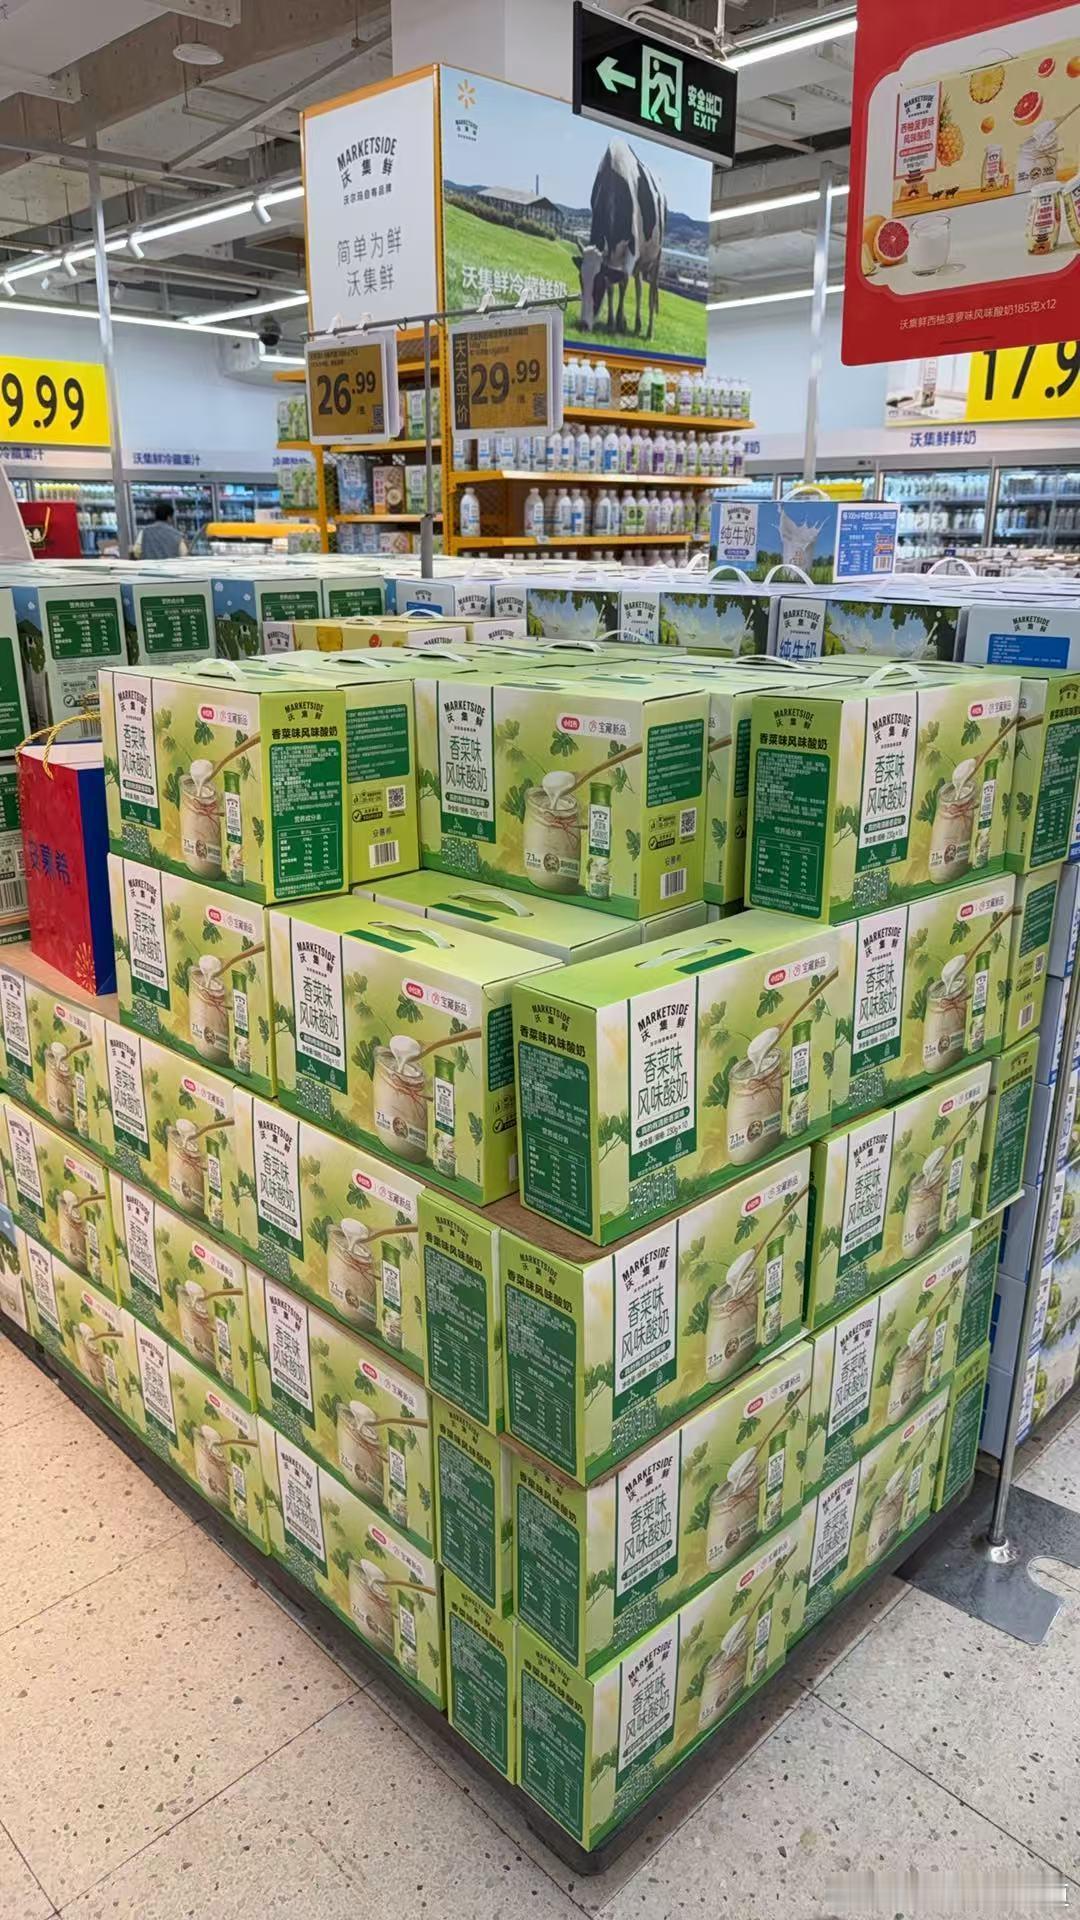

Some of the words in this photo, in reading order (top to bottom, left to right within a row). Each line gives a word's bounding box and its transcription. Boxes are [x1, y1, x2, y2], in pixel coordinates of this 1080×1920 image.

[687, 85, 722, 118] 安全出口
[694, 111, 717, 132] EXIT
[337, 136, 397, 171] MARKETSIDE
[341, 158, 393, 188] 沃集鲜
[337, 226, 402, 267] 简单为鲜
[347, 264, 394, 297] 沃集鲜
[317, 371, 376, 416] 26.99
[456, 334, 469, 425] 天天平价
[471, 358, 541, 405] 29.99
[1, 372, 84, 430] 9.99
[910, 430, 977, 448] 沃集鲜鲜奶
[720, 525, 756, 546] 纯牛奶
[623, 600, 656, 613] MARKETSIDE
[783, 608, 821, 624] MARKETSIDE
[1012, 614, 1050, 626] MARKETSIDE
[118, 688, 147, 708] MARKETSIDE
[285, 700, 325, 714] MARKETSIDE
[444, 699, 486, 717] MARKETSIDE
[446, 710, 483, 728] 沃集鲜
[599, 721, 627, 736] 宝藏新品
[774, 708, 815, 722] MARKETSIDE
[872, 712, 912, 731] MARKETSIDE
[123, 723, 148, 751] 香菜味
[271, 726, 338, 741] 香菜味风味酸奶
[759, 732, 828, 751] 香菜味风味酸奶
[874, 725, 909, 744] 沃集鲜
[449, 735, 482, 763] 香菜味
[121, 750, 152, 781] 风味酸奶
[445, 762, 488, 793] 风味酸奶
[874, 753, 905, 784] 香菜味
[866, 782, 908, 815] 风味酸奶
[128, 879, 158, 895] MARKETSIDE
[864, 927, 902, 948] MARKETSIDE
[297, 942, 336, 965] MARKETSIDE
[299, 953, 334, 974] 沃集鲜
[866, 962, 895, 994] 香菜味
[303, 976, 333, 1011] 香菜味
[300, 1001, 339, 1041] 风味酸奶
[531, 1003, 571, 1024] MARKETSIDE
[637, 1003, 690, 1031] MARKETSIDE
[520, 1024, 586, 1058] 香菜味风味酸奶
[641, 1017, 686, 1043] 沃集鲜
[643, 1041, 683, 1084] 香菜味
[637, 1071, 689, 1120] 风味酸奶
[258, 1119, 292, 1146] MARKETSIDE
[853, 1133, 888, 1158] MARKETSIDE
[262, 1151, 290, 1185] 香菜味
[425, 1231, 483, 1271] 香菜味风味酸奶
[519, 1253, 558, 1279] MARKETSIDE
[622, 1245, 671, 1280] MARKETSIDE
[624, 1259, 667, 1292] 沃集鲜
[507, 1269, 573, 1313] 香菜味风味酸奶
[269, 1296, 303, 1323] MARKETSIDE
[628, 1285, 664, 1328] 香菜味
[620, 1308, 670, 1364] 风味酸奶
[625, 1456, 673, 1495] MARKETSIDE
[631, 1491, 667, 1534] 香菜味
[623, 1511, 672, 1566] 风味酸奶
[628, 1639, 673, 1682] MARKETSIDE
